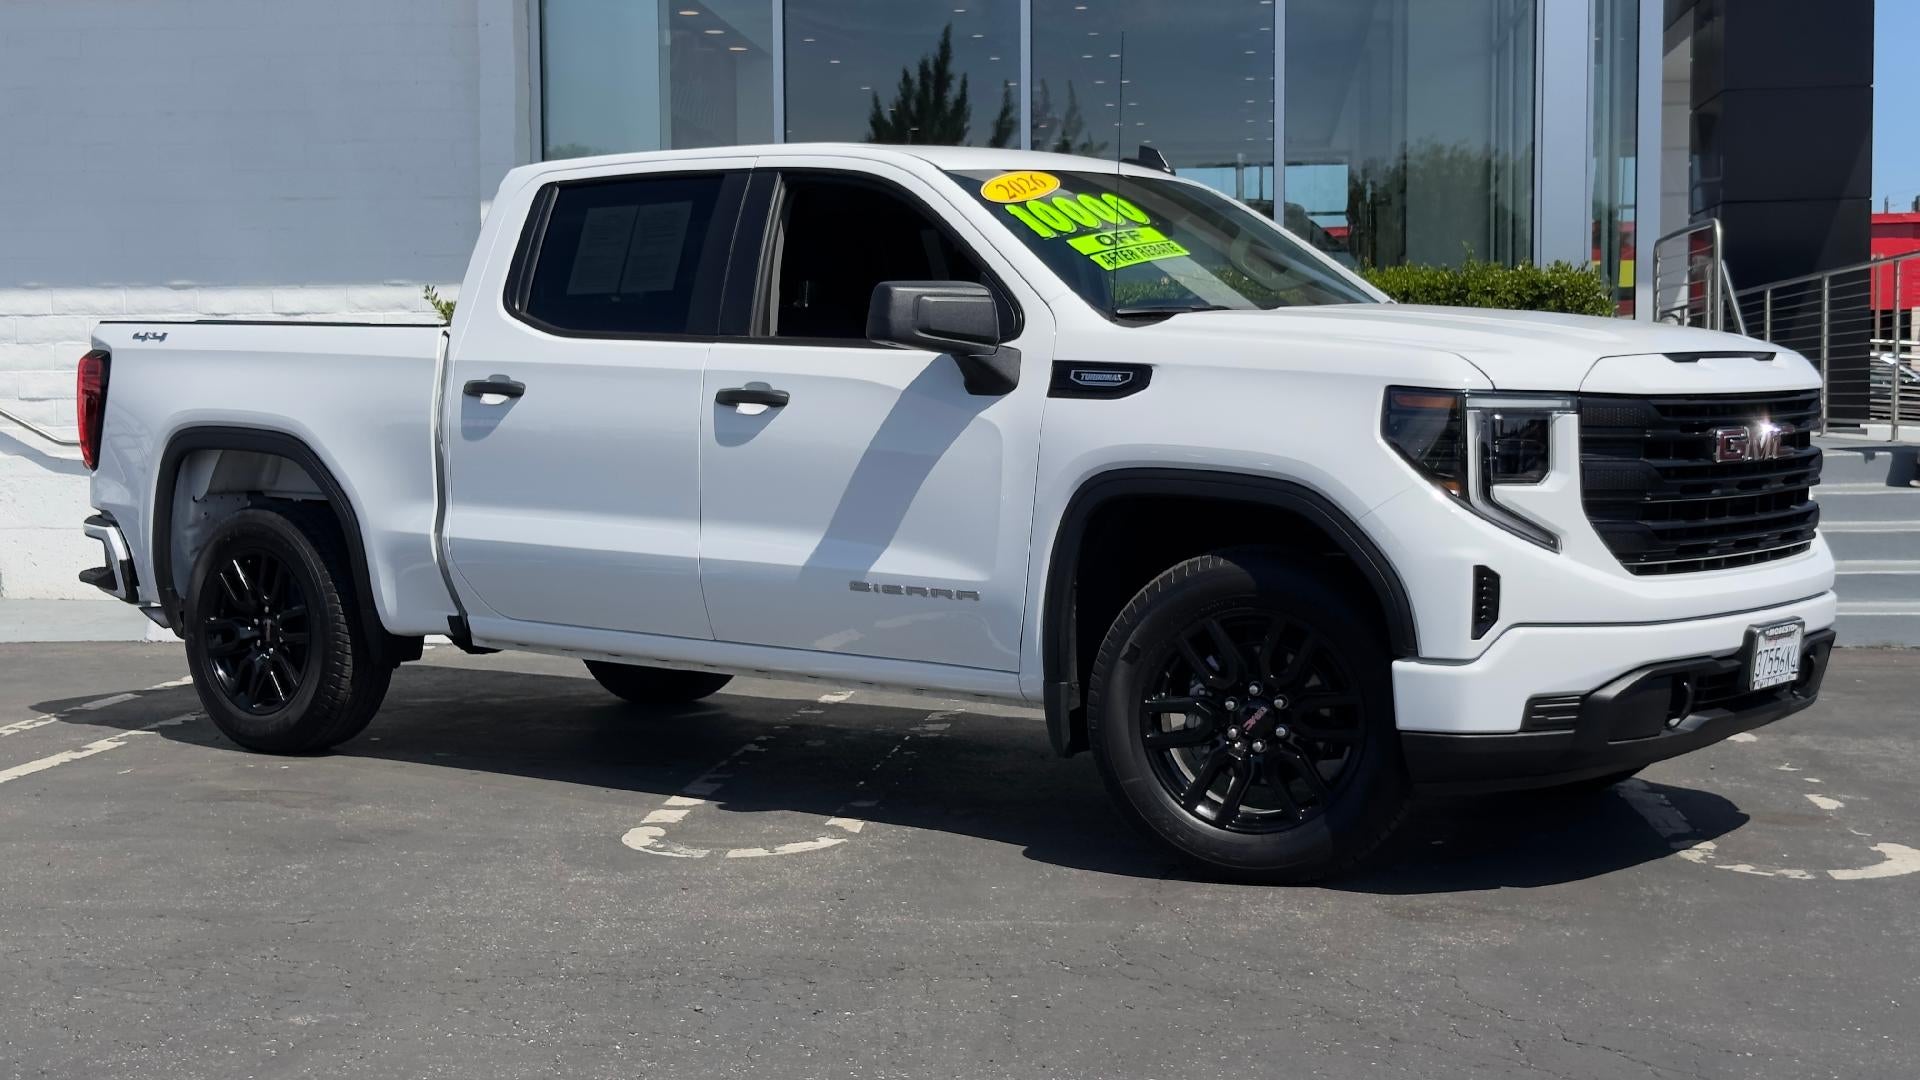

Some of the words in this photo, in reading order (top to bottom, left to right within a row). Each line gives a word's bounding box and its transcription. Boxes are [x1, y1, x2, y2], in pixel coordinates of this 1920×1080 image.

[996, 174, 1047, 200] 2026
[1005, 193, 1151, 238] 10000
[1095, 230, 1144, 246] OFF
[1100, 249, 1140, 266] AFTER
[1137, 242, 1184, 259] REBATE
[1080, 373, 1123, 381] TURBOMAX
[1716, 425, 1796, 463] GMC
[849, 581, 980, 601] SIERRA
